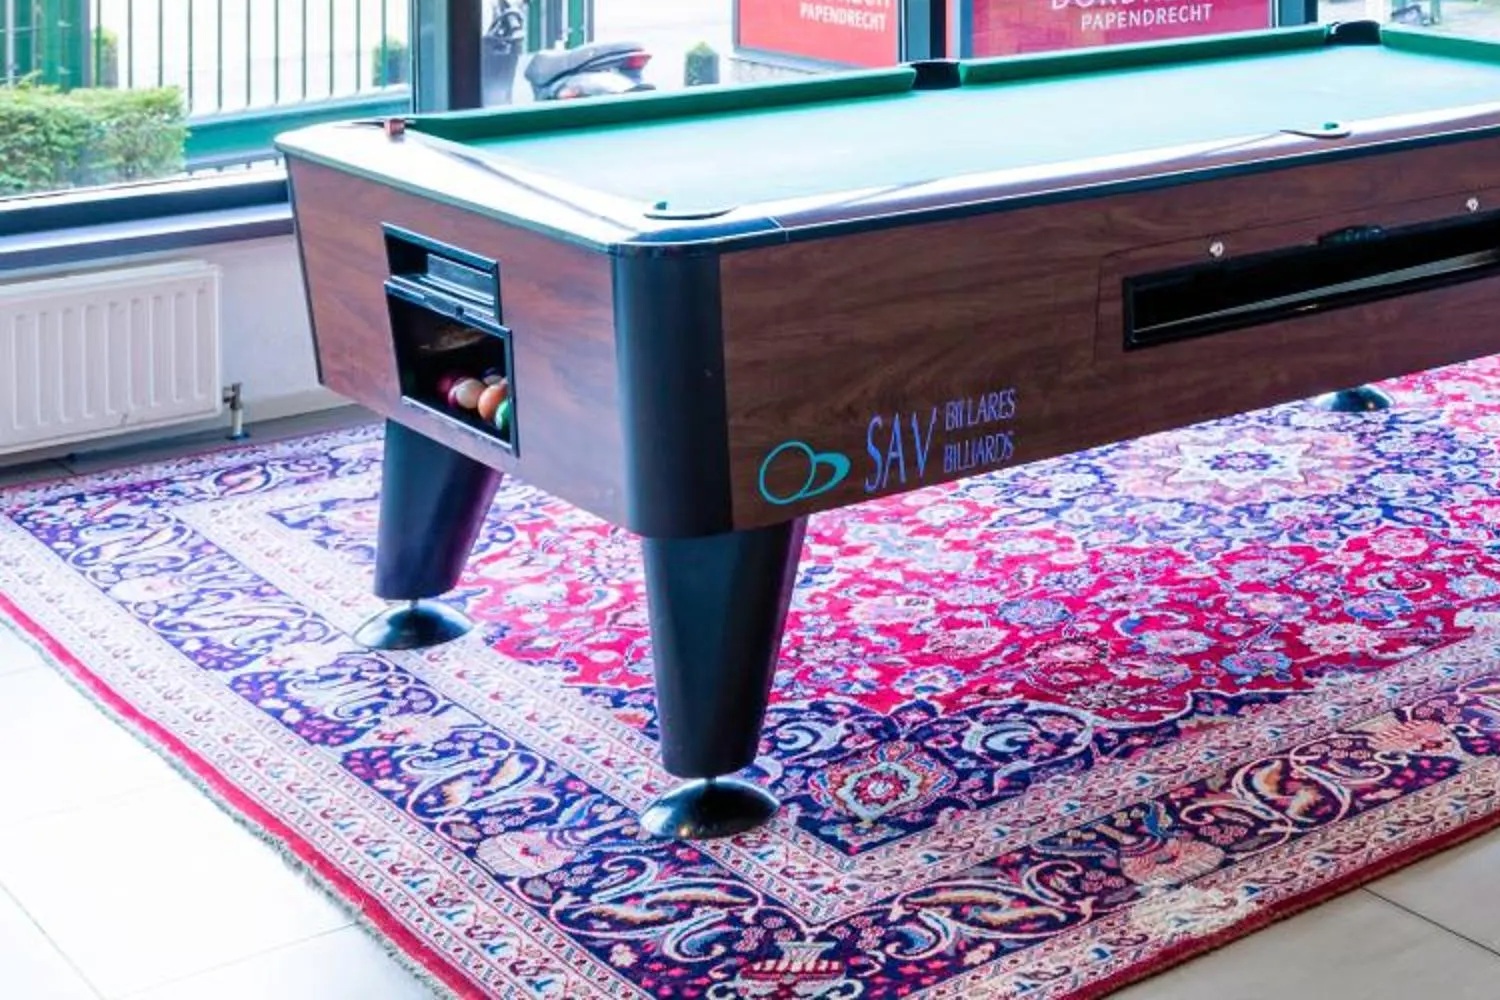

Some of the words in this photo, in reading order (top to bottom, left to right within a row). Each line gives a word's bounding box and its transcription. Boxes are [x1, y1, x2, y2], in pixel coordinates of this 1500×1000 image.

[800, 2, 887, 31] PAPENDRECHT
[1080, 3, 1213, 31] PAPENDRECHT
[945, 388, 1016, 431] BILLARES
[863, 407, 937, 493] SAV
[943, 431, 1014, 474] BILLIARDS
